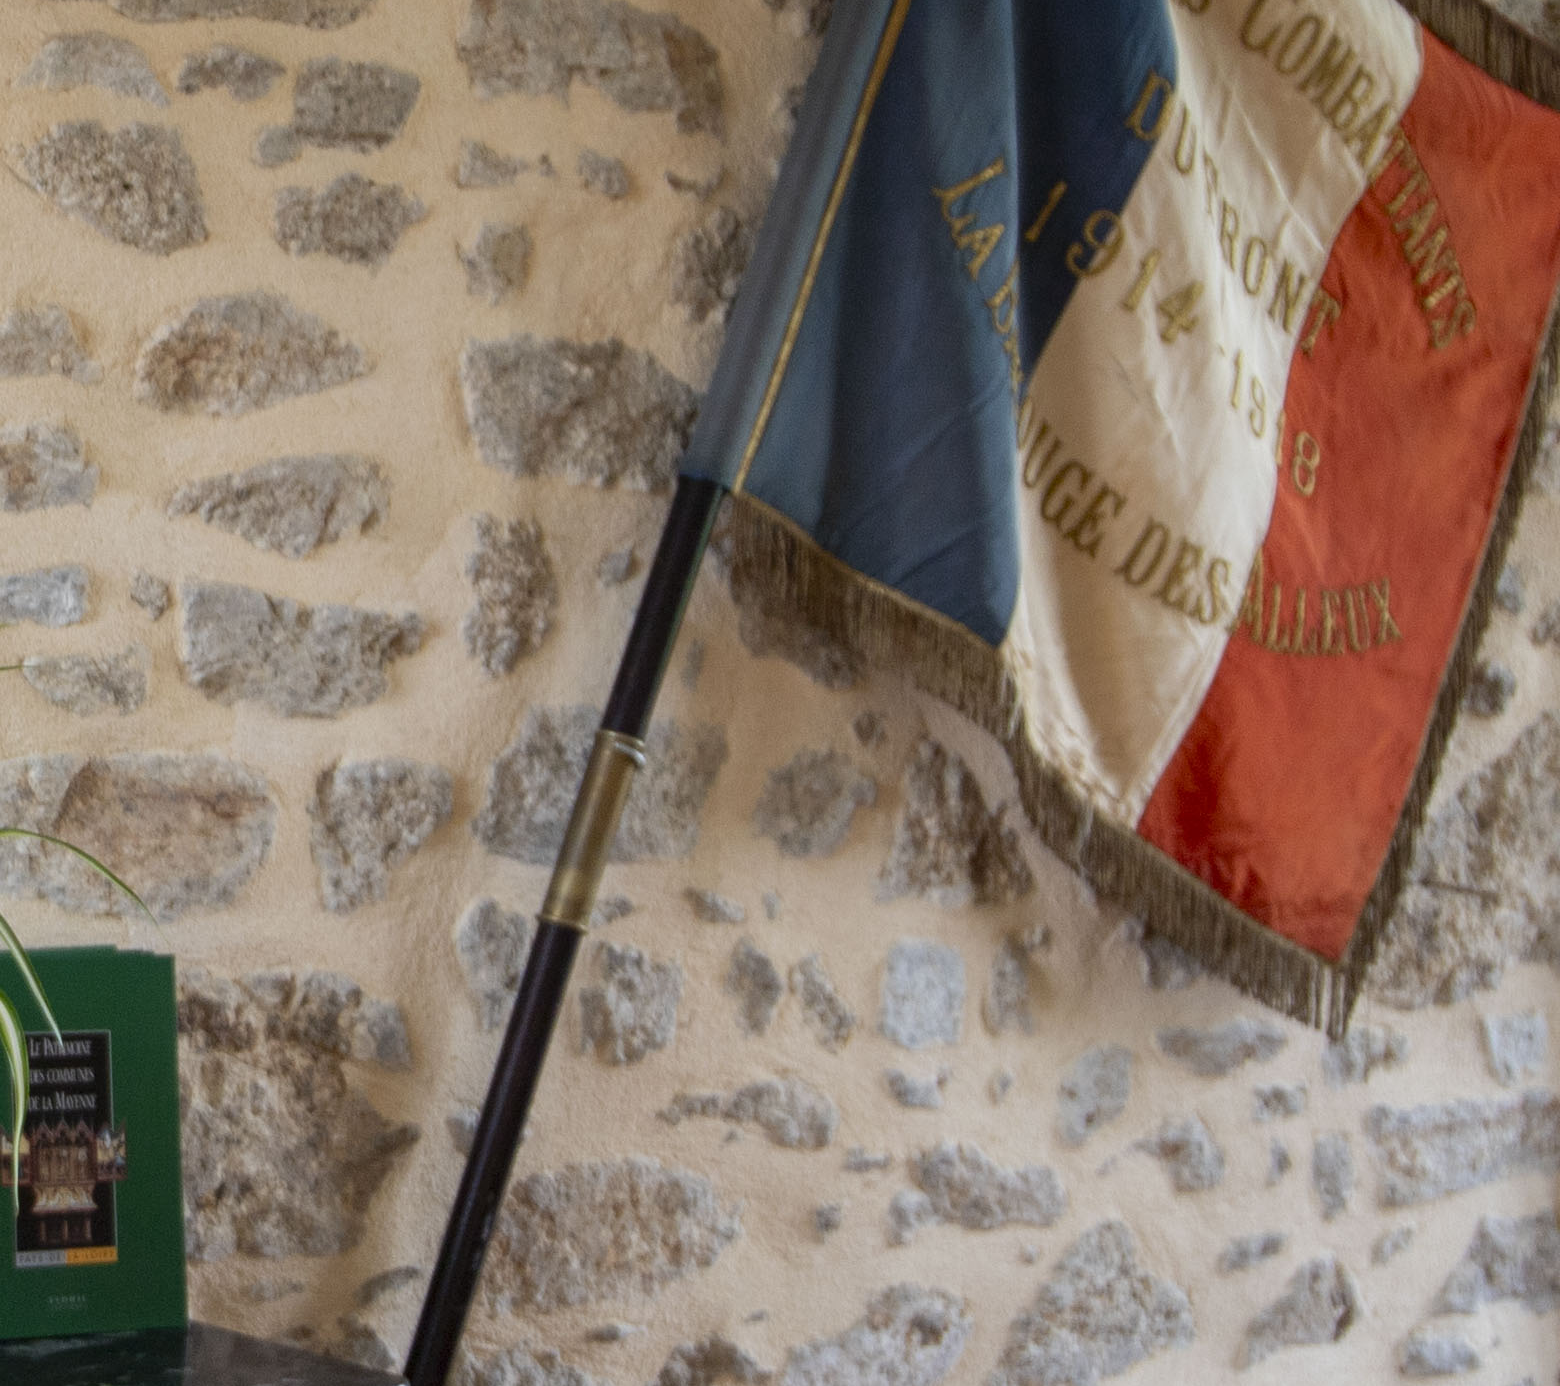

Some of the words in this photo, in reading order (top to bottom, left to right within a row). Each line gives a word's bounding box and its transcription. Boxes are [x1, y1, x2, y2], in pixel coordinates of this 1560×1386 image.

[933, 157, 1007, 282] LA
[1113, 515, 1231, 625] DES
[1225, 543, 1404, 657] ALLEUX
[1124, 69, 1197, 176] DU
[1202, 147, 1341, 356] FRONT
